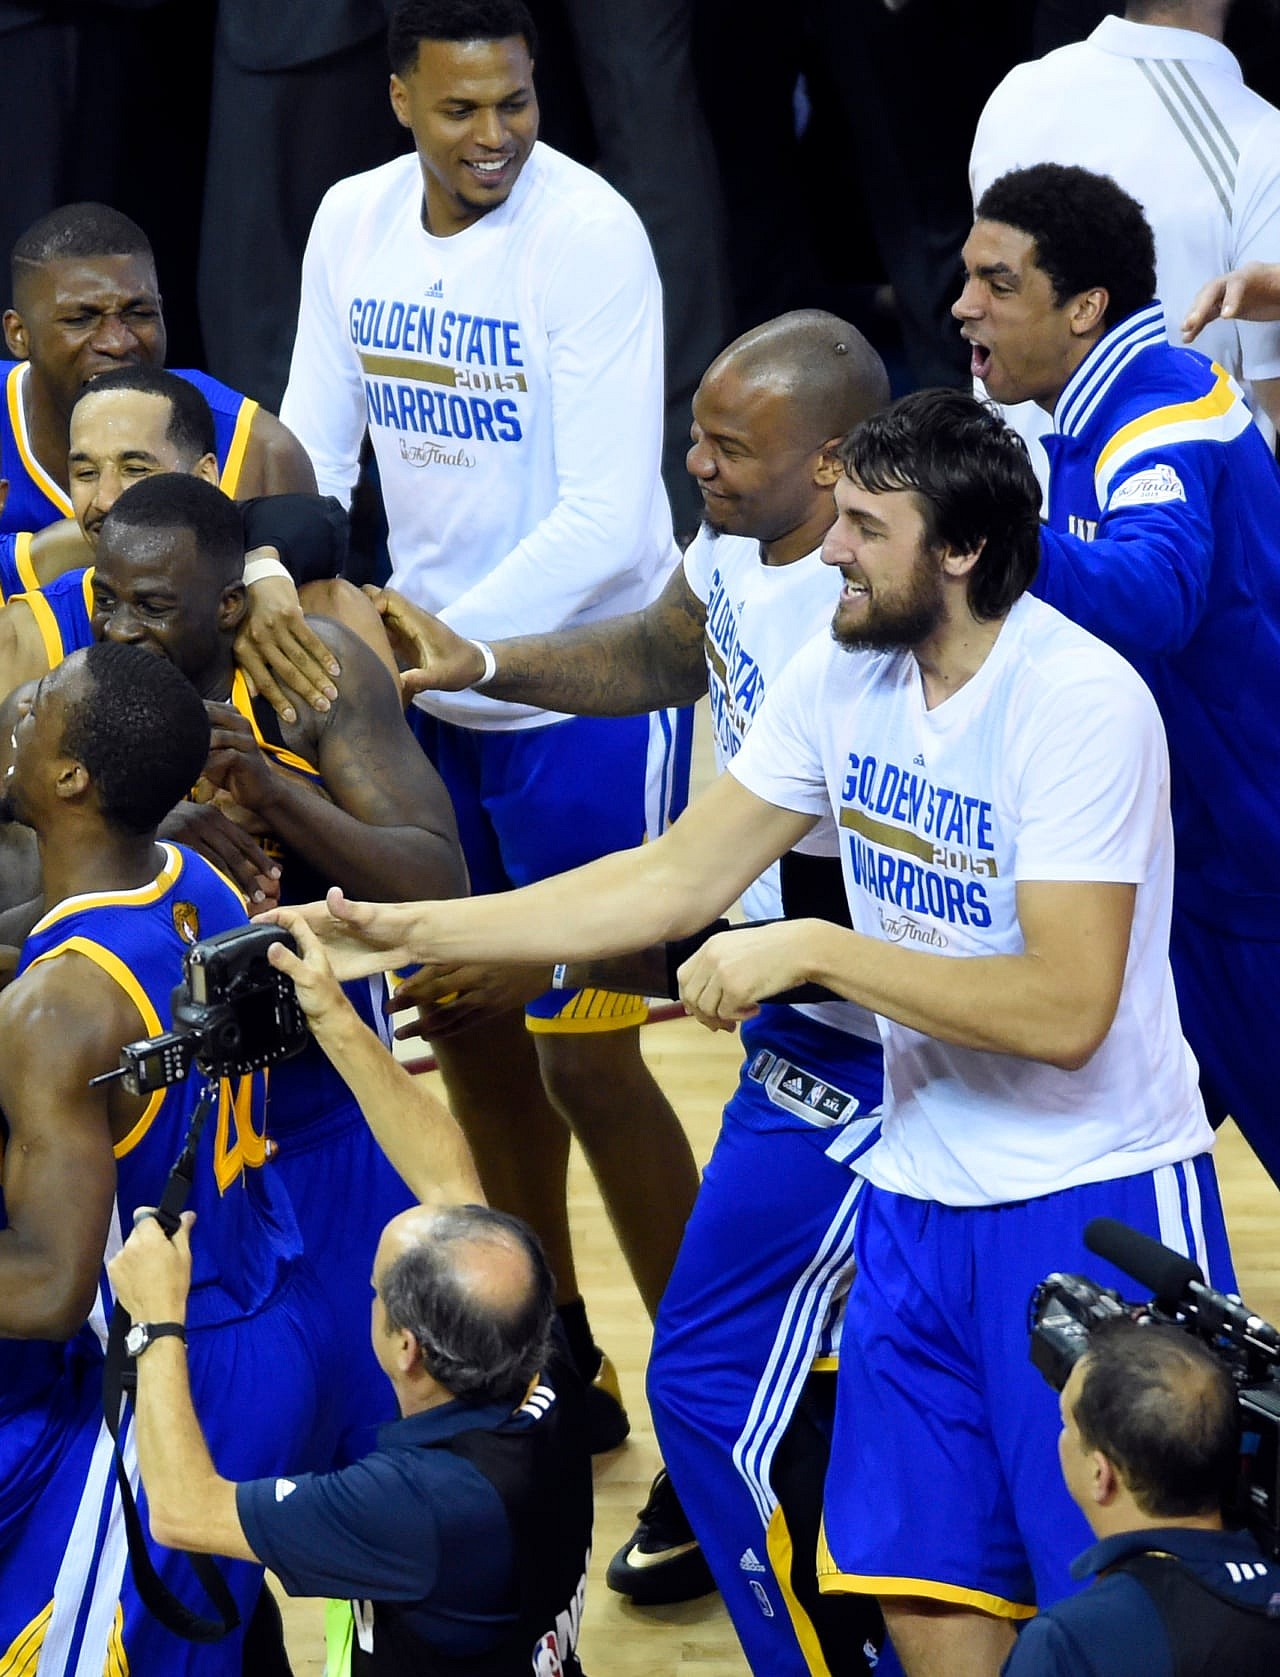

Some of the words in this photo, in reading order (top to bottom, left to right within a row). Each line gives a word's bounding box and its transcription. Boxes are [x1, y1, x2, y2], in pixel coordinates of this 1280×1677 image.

[349, 297, 435, 355] GOLDEN
[439, 310, 524, 366] STATE
[455, 368, 526, 392] 2015
[408, 441, 476, 468] Finals
[924, 784, 994, 851] STATE
[849, 835, 993, 928] WARRIORS
[887, 915, 949, 948] Finals
[822, 1098, 840, 1113] 3XL
